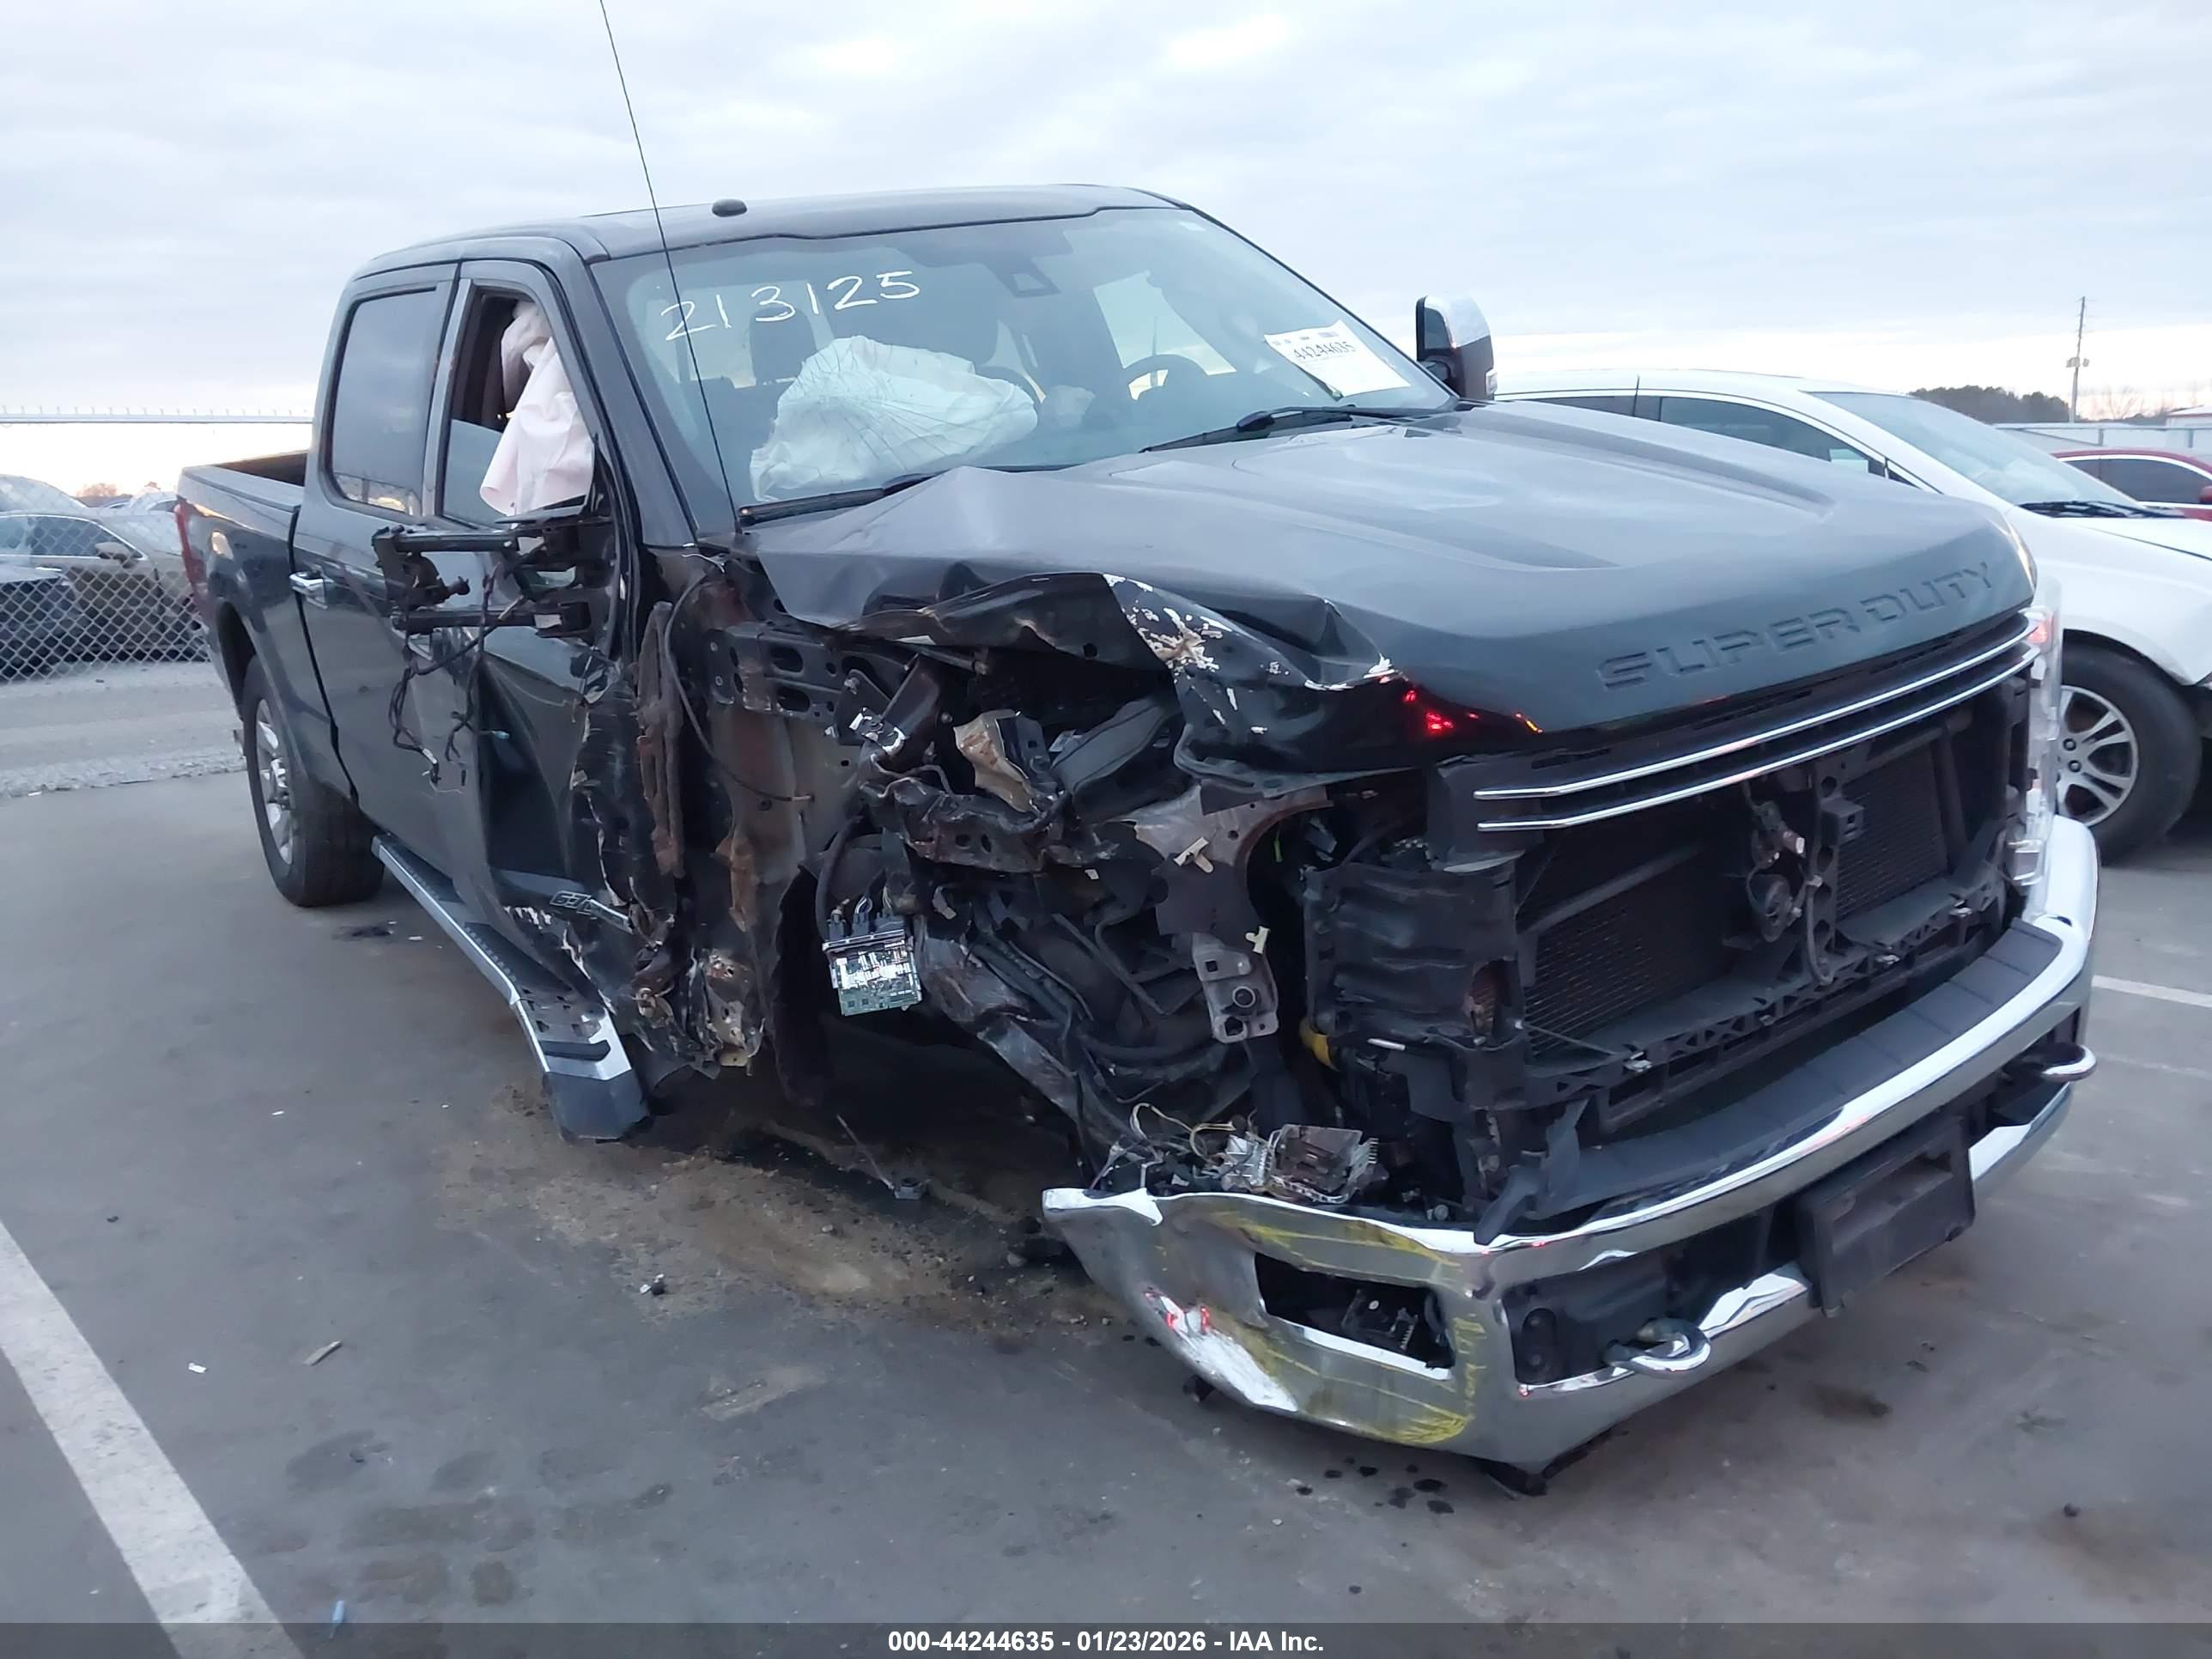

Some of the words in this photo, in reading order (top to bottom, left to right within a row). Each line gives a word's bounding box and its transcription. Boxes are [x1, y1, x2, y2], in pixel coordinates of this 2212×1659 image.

[1293, 341, 1357, 360] 44244635
[1595, 607, 1862, 690] SUPER
[1859, 562, 1994, 622] DUTY
